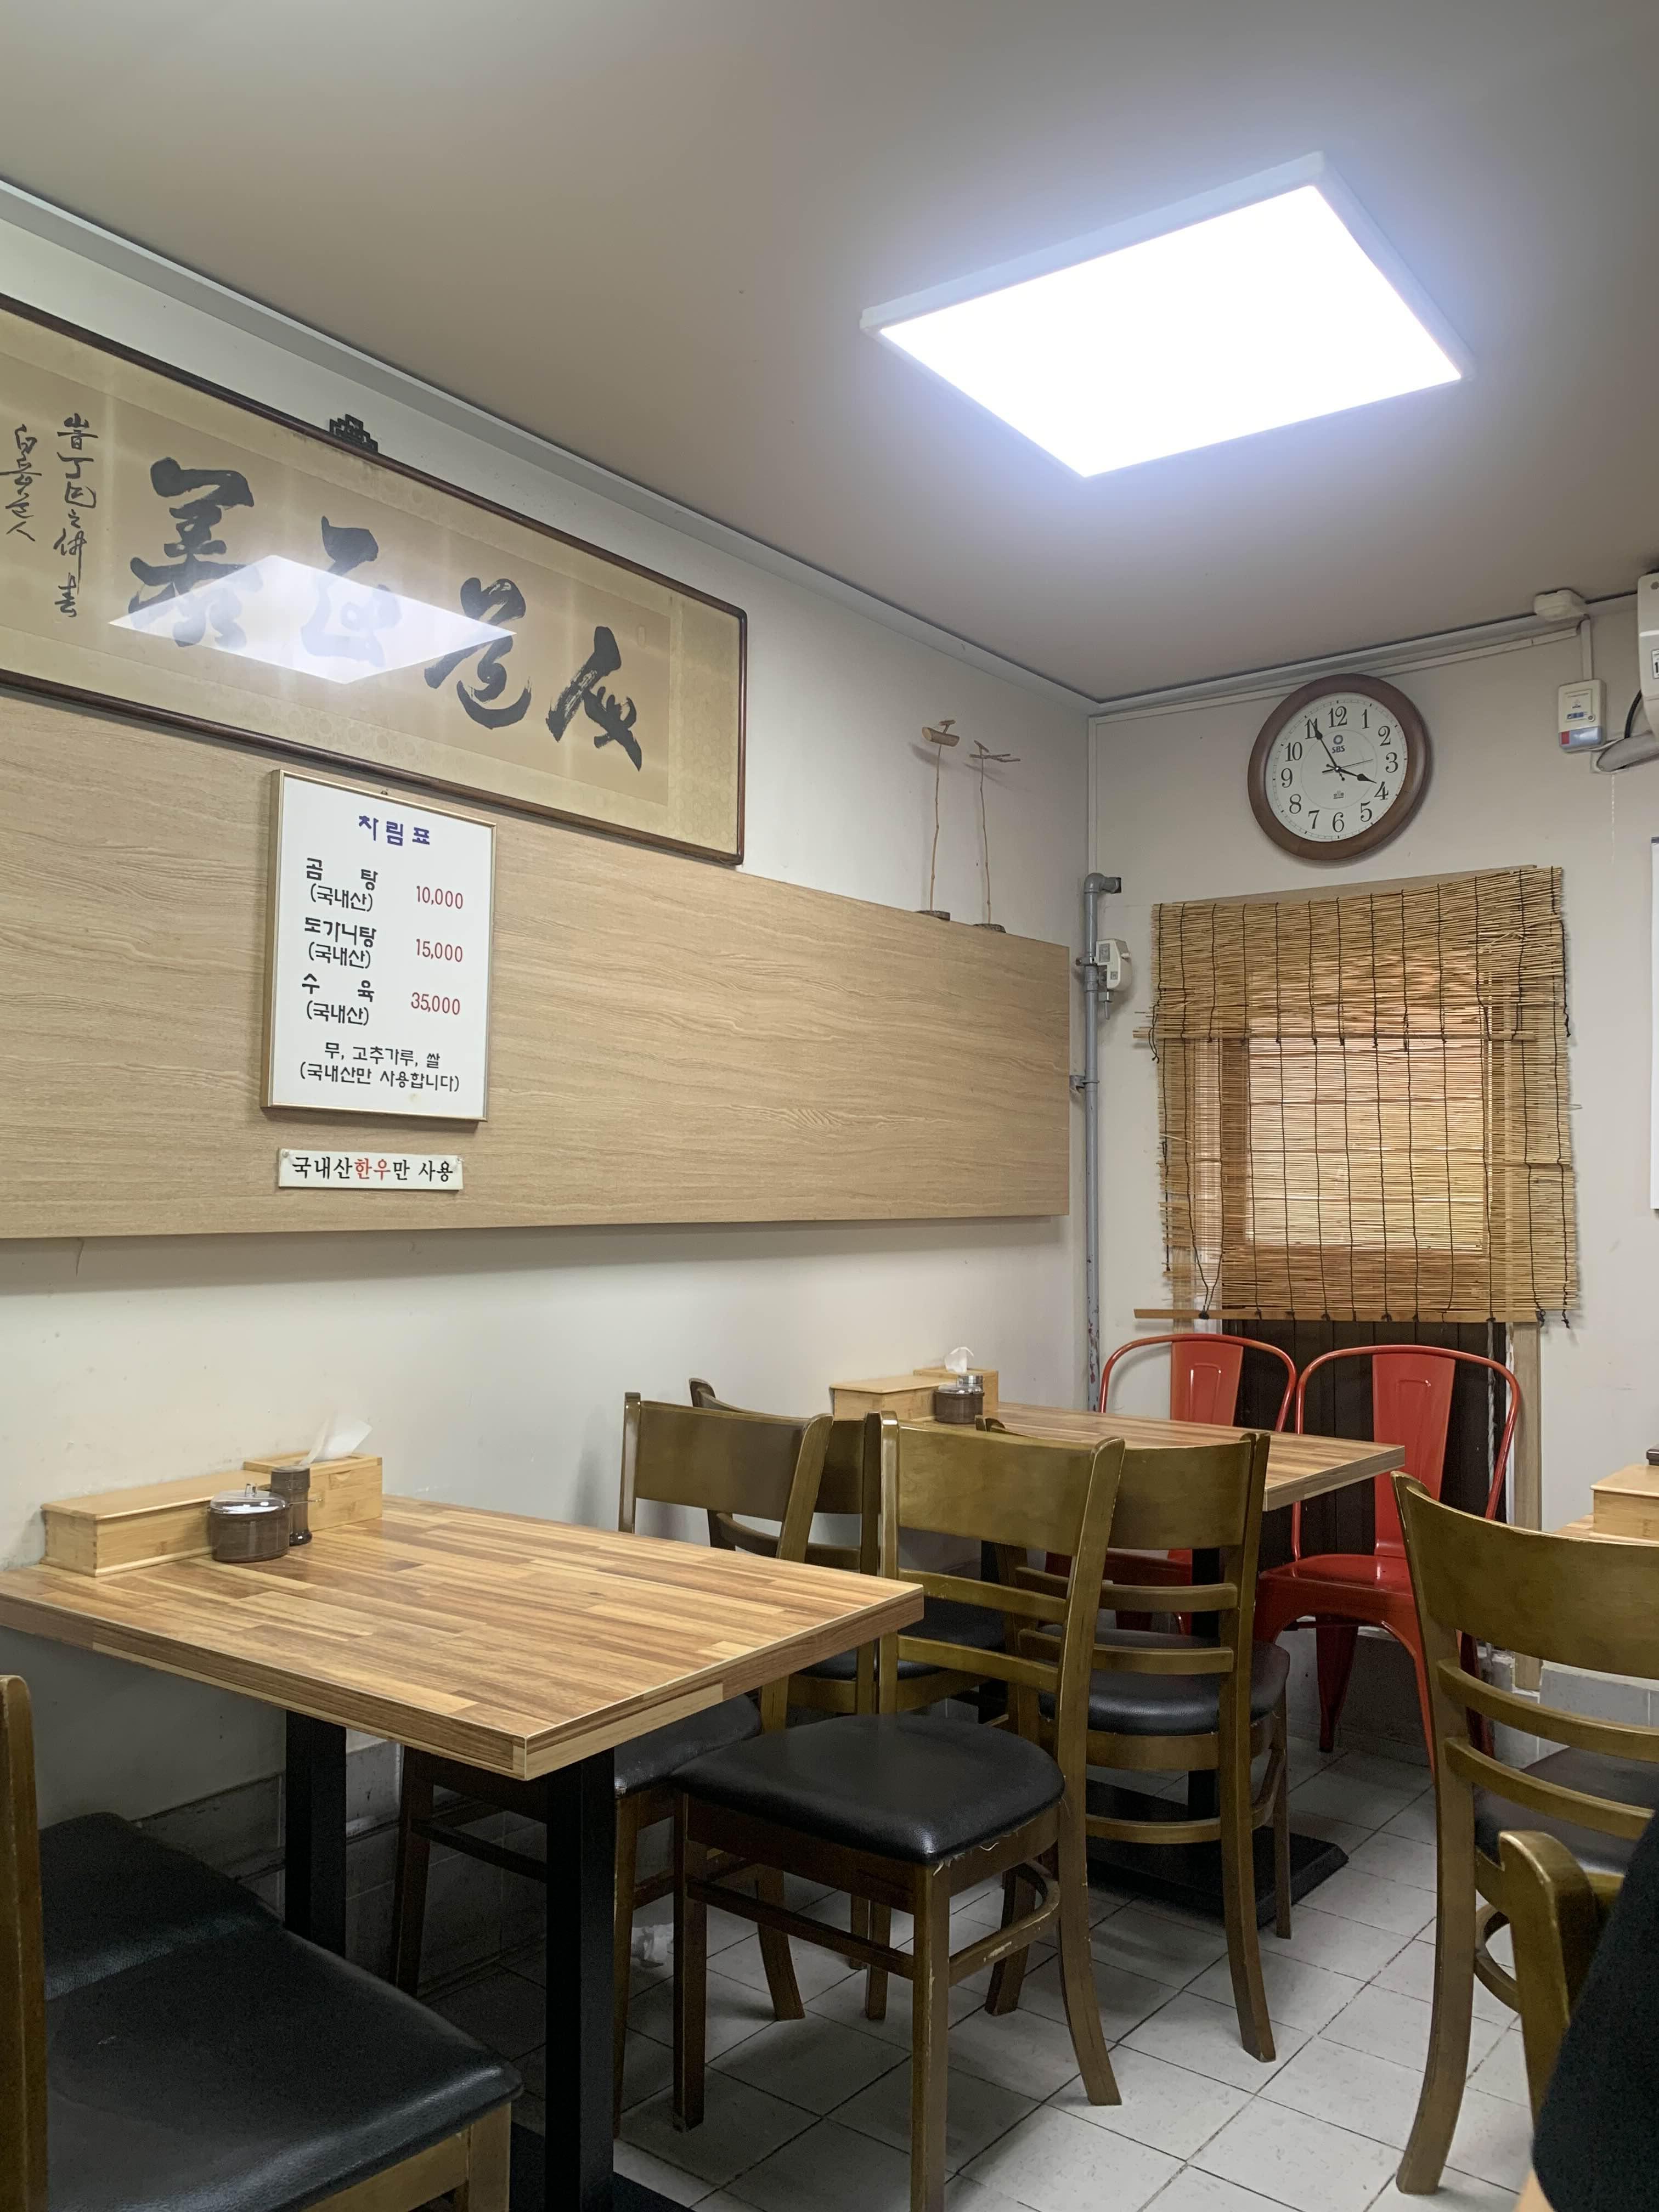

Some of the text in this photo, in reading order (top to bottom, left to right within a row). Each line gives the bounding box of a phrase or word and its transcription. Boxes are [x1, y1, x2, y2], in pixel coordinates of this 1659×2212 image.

[1328, 706, 1347, 728] 12
[1361, 709, 1369, 729] 1
[1378, 726, 1390, 746] 2
[1284, 742, 1302, 761] 10
[1331, 745, 1346, 754] SBS
[1386, 752, 1398, 773] 3
[1281, 768, 1293, 788] 9
[1374, 781, 1389, 800] 4
[1289, 794, 1301, 814] 8
[1361, 801, 1373, 822] 5
[1308, 810, 1319, 829] 7
[1333, 812, 1344, 832] 6
[311, 883, 373, 912] (국내산)
[416, 886, 462, 909] 10,000
[304, 917, 376, 947] 도가니탕
[309, 942, 370, 969] (국내산)
[416, 939, 462, 962] 15,000
[307, 1001, 369, 1025] (국내산)
[411, 992, 460, 1015] 35,000
[325, 1042, 440, 1069] 무, 고추가루, 쌀
[301, 1062, 459, 1092] (국내산만 사용합니다)
[292, 1156, 453, 1182] 국내산한우만 사용
